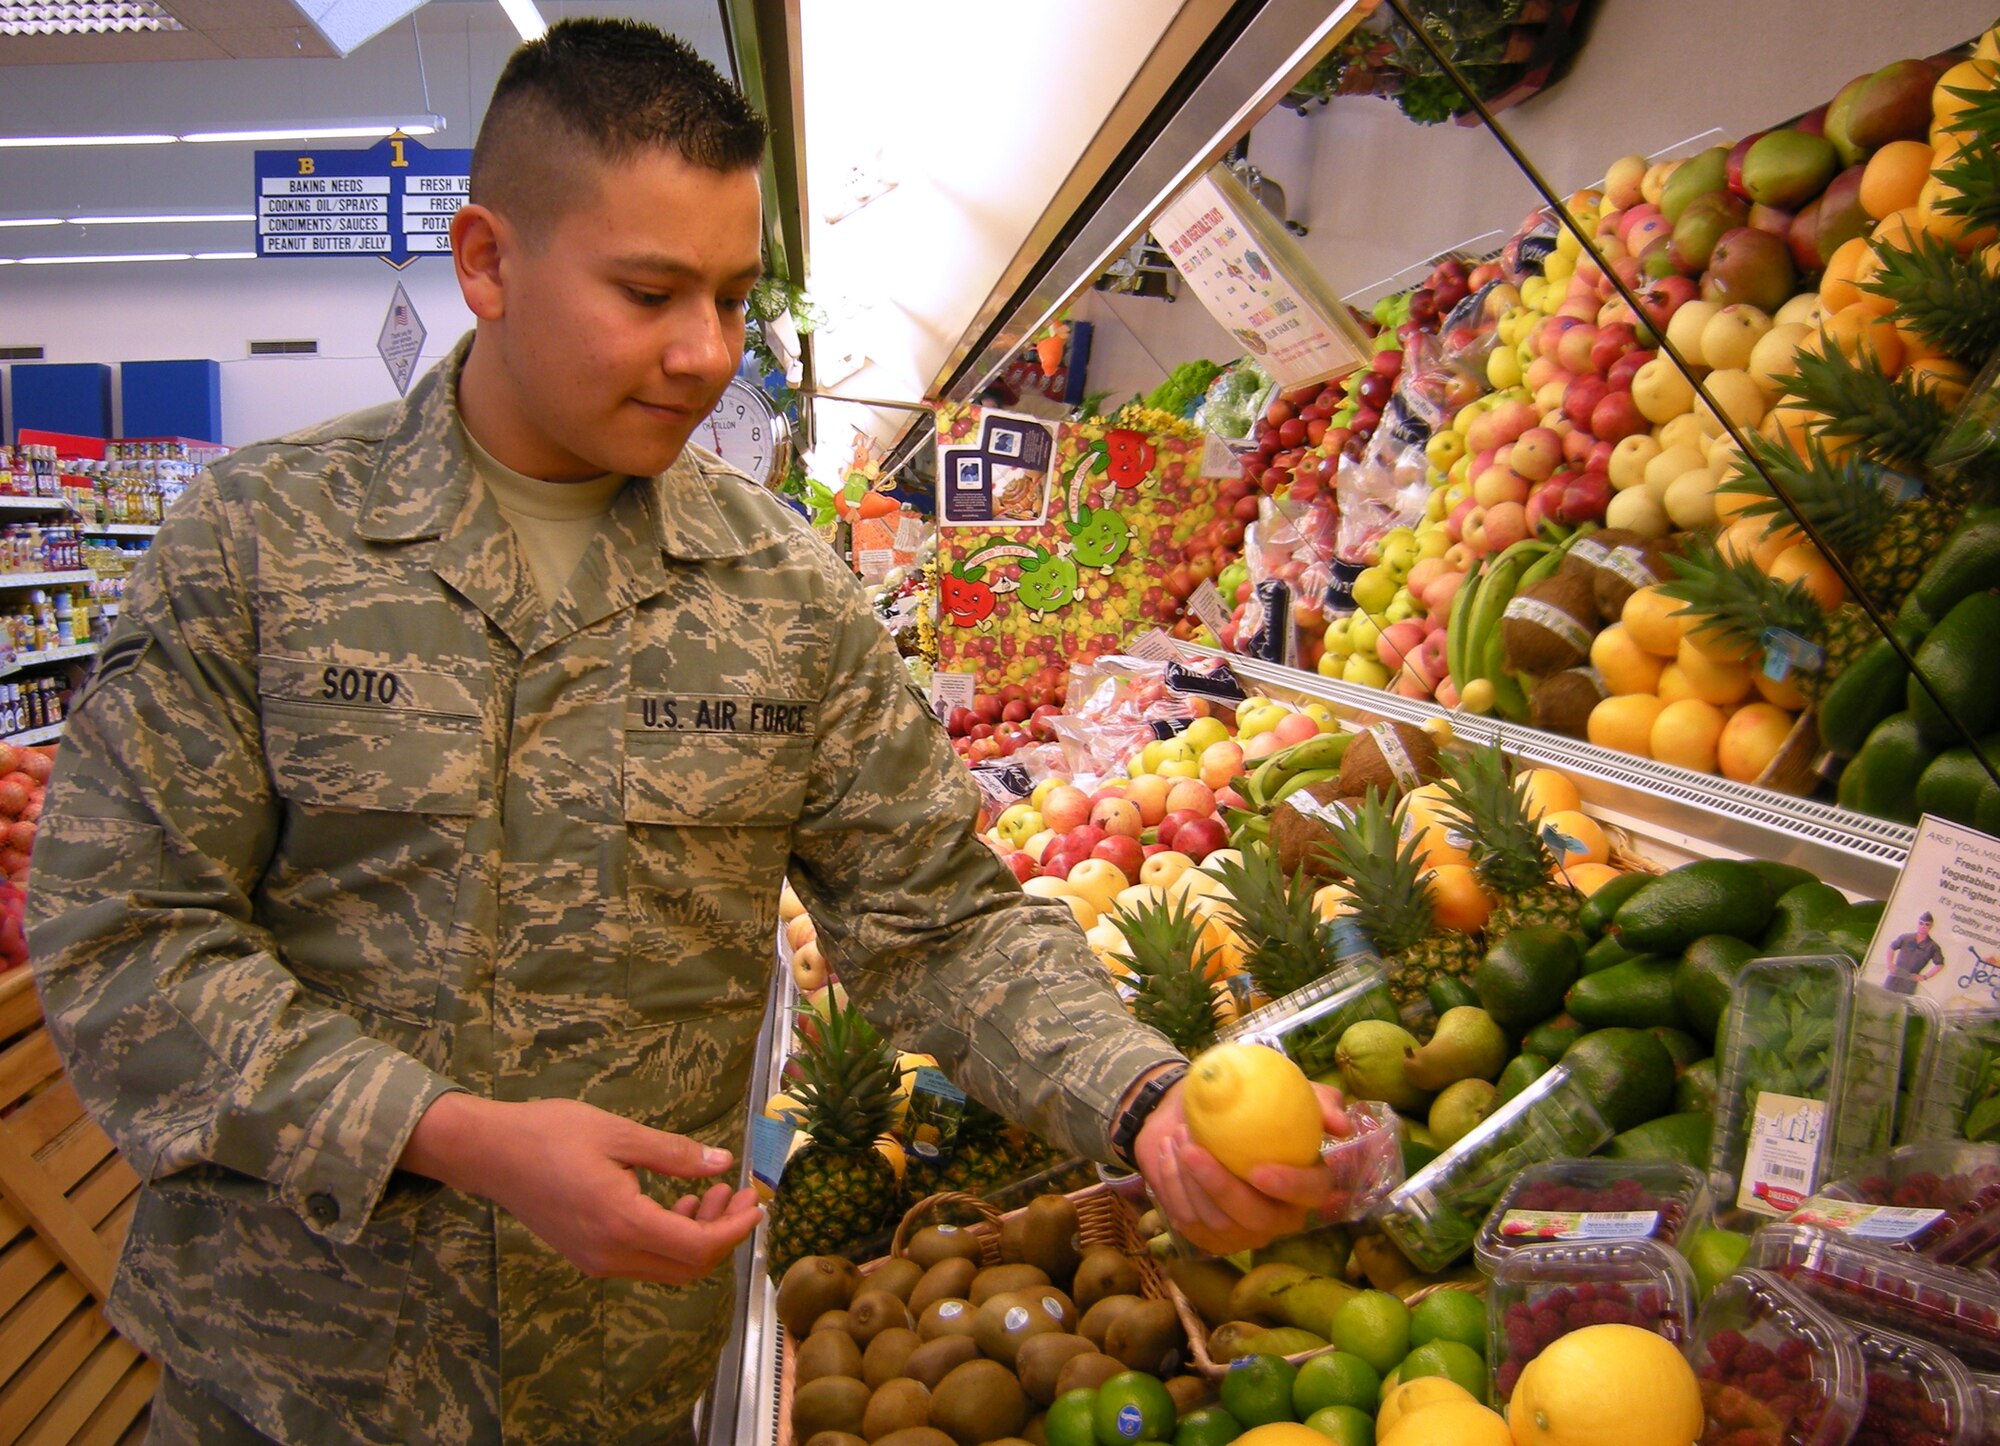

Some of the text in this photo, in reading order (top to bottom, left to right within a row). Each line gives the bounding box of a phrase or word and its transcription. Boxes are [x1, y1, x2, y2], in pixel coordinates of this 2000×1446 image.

[390, 140, 409, 168] 1
[297, 157, 315, 174] B
[289, 179, 363, 193] BAKING NEEDS
[420, 178, 452, 191] FRESH
[268, 198, 379, 212] COOKING OIL/SPRAYS
[430, 197, 462, 210] FRESH
[268, 217, 378, 231] CONDIMENTS/SAUCES
[267, 236, 387, 250] PEANUT BUTTER/JELLY
[736, 405, 745, 420] 9
[752, 427, 761, 441] 8
[753, 456, 762, 471] 7
[322, 666, 399, 704] SOTO
[642, 699, 808, 734] U.S. AIR FORCE
[1926, 831, 1953, 845] ARE
[1954, 840, 1980, 856] YOU
[1954, 856, 1984, 874] Fresh
[1941, 864, 1996, 891] Vegetables
[1939, 878, 1997, 906] War Fighter
[1952, 902, 1973, 913] your
[1951, 912, 1982, 930] healthy
